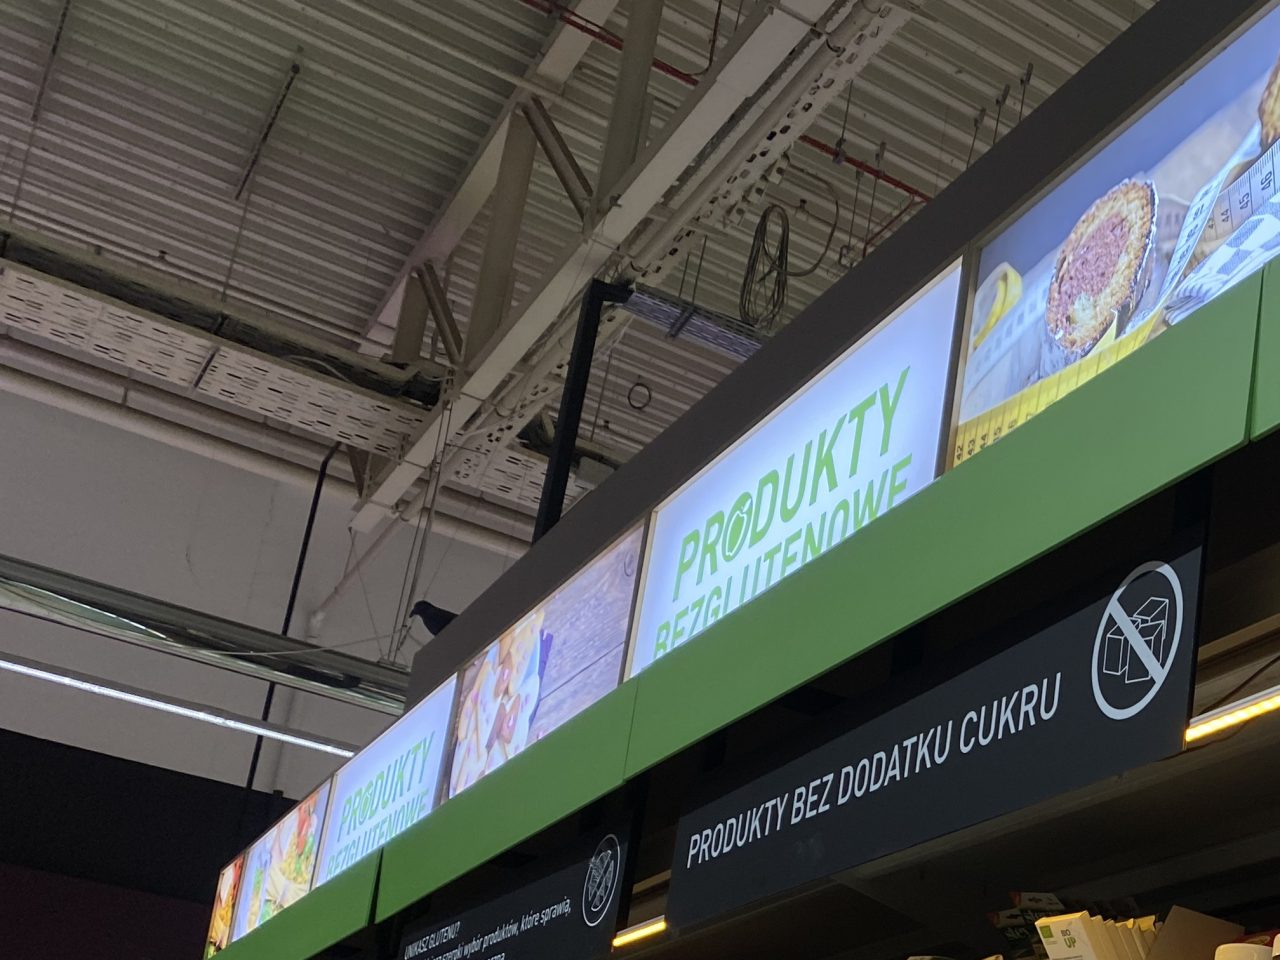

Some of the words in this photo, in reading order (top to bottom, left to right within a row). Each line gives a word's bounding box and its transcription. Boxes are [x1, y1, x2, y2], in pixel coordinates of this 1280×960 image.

[1260, 171, 1273, 191] 46
[673, 365, 910, 603] PRODUKTY
[338, 731, 435, 842] PRODUKTY
[687, 793, 789, 869] PRODUKTY
[791, 774, 834, 825] BEZ
[837, 721, 954, 805] DODATKU
[959, 672, 1061, 754] CUKRU
[404, 935, 429, 960] UNIKASZ
[520, 910, 539, 932] które
